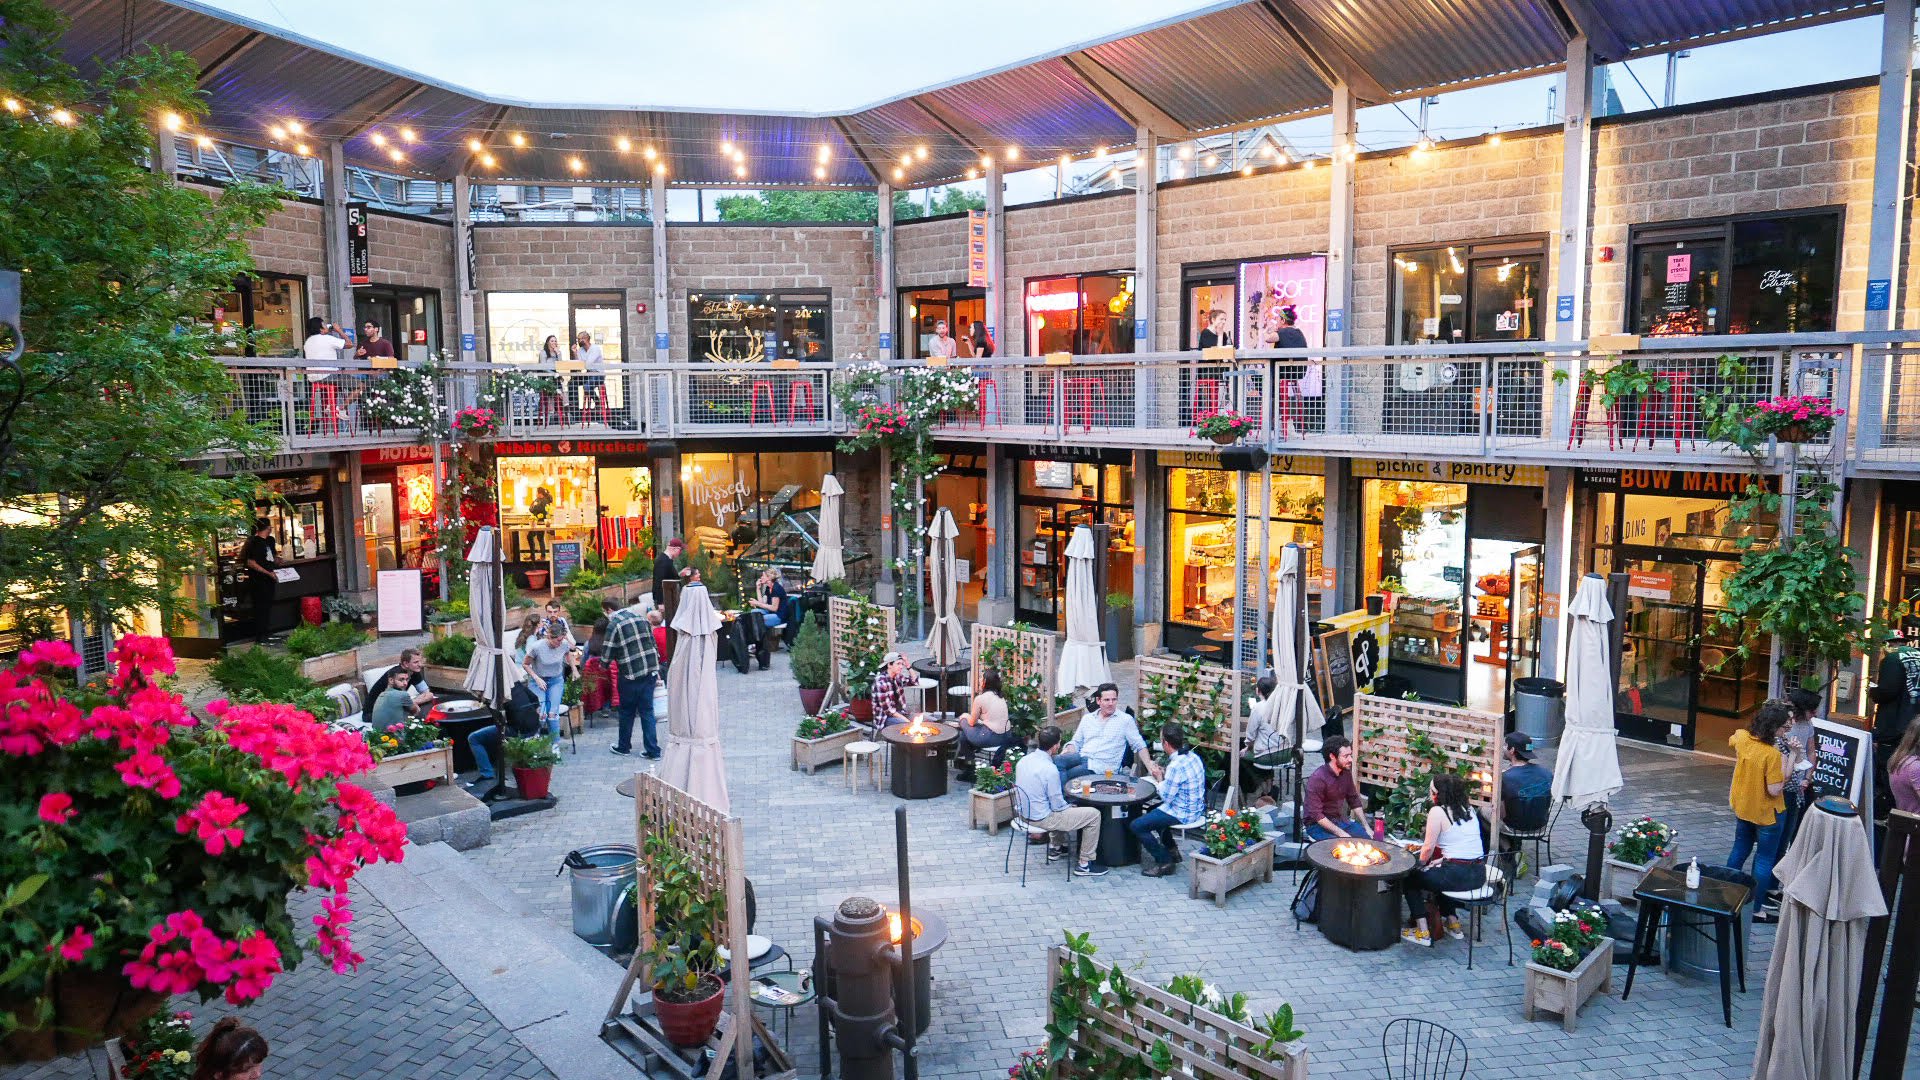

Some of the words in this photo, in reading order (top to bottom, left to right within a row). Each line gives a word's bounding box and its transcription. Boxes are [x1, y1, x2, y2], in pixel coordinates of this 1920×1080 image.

[1274, 278, 1318, 299] SOFT
[1272, 304, 1321, 324] SCE
[494, 440, 552, 454] Nibble
[577, 441, 648, 453] Kitchen
[1028, 444, 1102, 459] REMNANT
[1376, 460, 1425, 476] picnic
[1432, 461, 1442, 475] &
[1451, 462, 1517, 482] pantry
[1591, 476, 1617, 484] SEATING
[1620, 468, 1672, 490] BOW
[688, 469, 750, 506] Missed
[709, 494, 744, 527] You!
[1817, 733, 1847, 749] TRULY
[1815, 749, 1850, 767] SUPPORT
[1816, 760, 1845, 777] LOCAL
